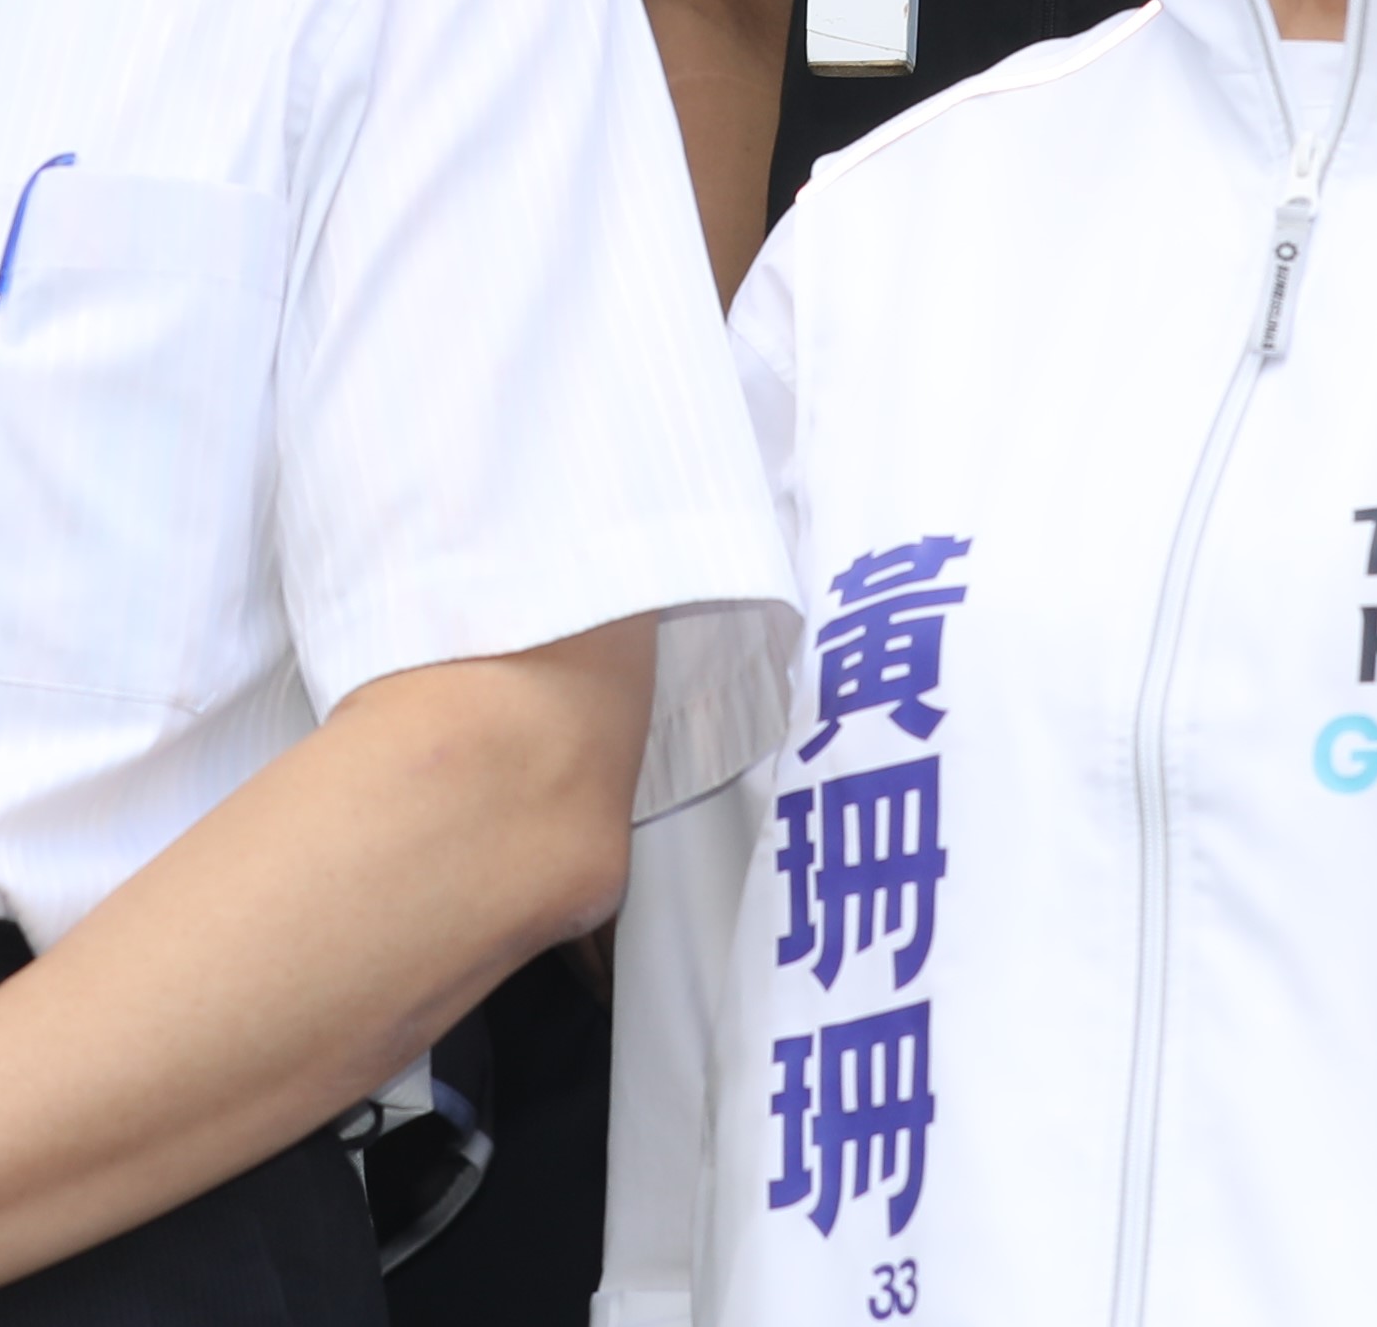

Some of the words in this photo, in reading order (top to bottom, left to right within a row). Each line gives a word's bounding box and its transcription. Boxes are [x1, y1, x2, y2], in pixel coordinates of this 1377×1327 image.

[768, 534, 974, 1238] 黃珊珊
[867, 1258, 919, 1322] 33
